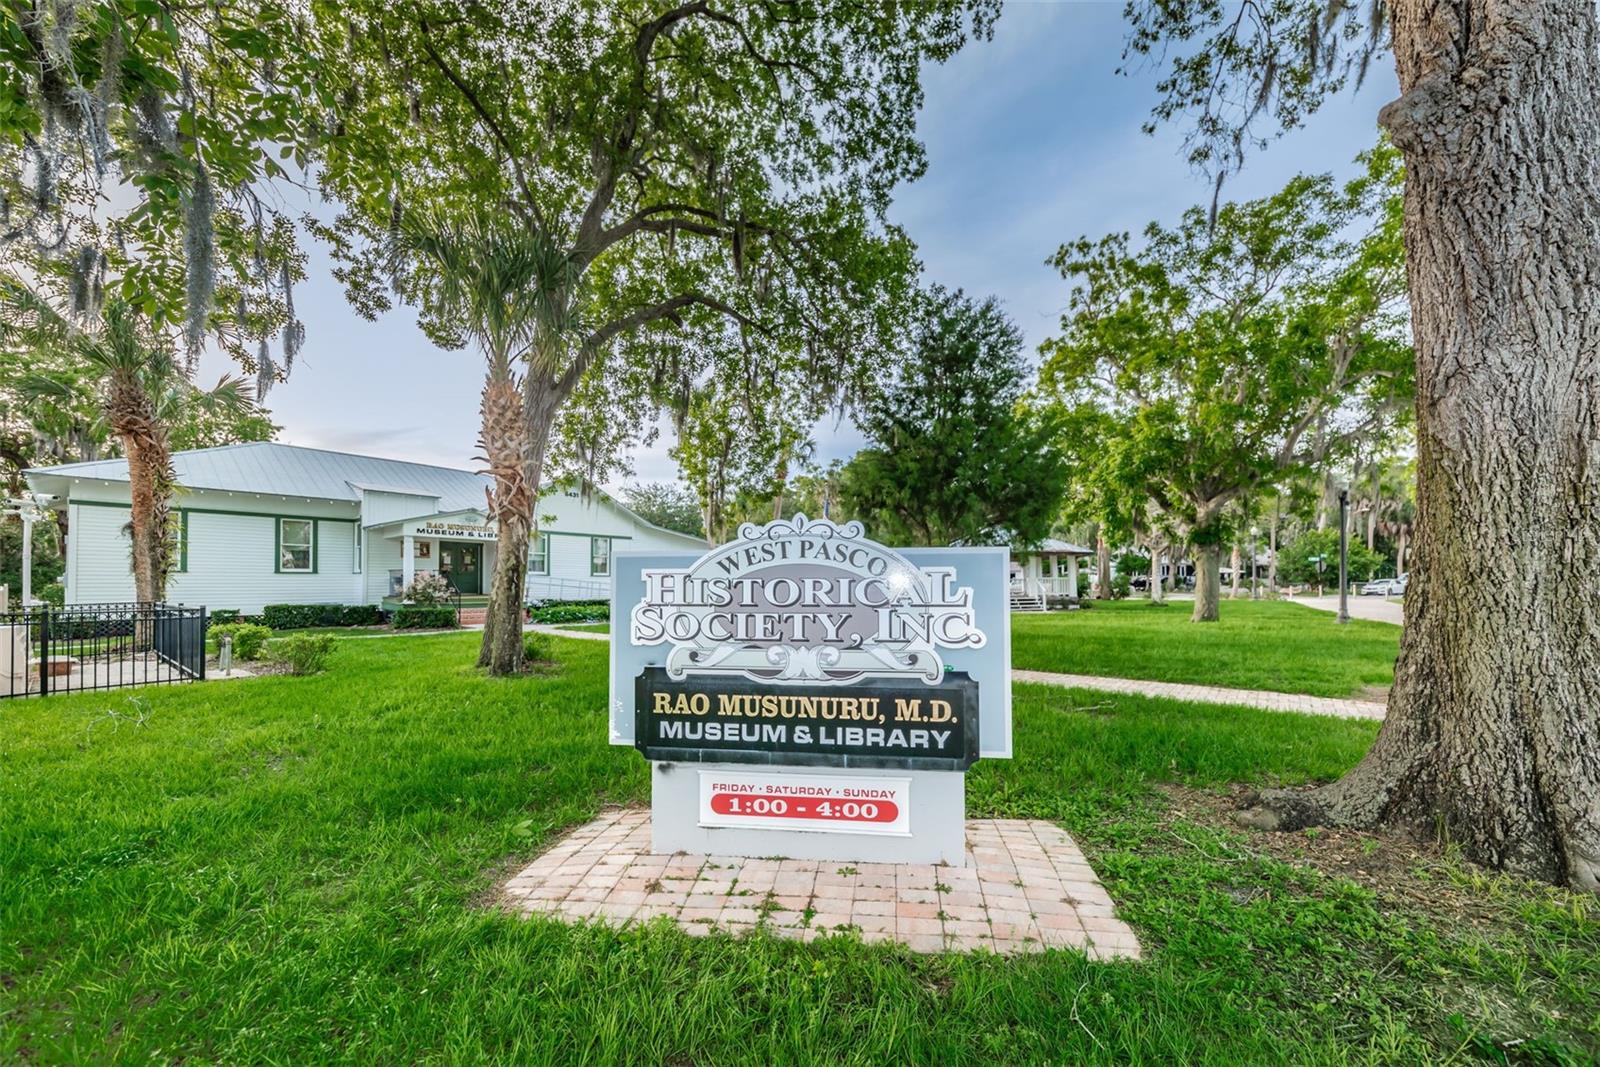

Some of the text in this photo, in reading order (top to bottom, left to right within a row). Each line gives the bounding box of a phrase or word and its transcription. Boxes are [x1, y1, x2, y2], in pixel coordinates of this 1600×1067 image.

[416, 528, 464, 537] MUSEUM
[716, 540, 888, 577] WEST PASCO
[646, 572, 969, 608] HISTORICAL
[635, 606, 982, 649] SOCIETY, INC.
[653, 692, 958, 724] RAO MUSUNURU, M.D.
[659, 721, 951, 749] MUSEUM & LIBRARY
[712, 783, 896, 799] FRIDAY SATURDAY SUNDAY
[729, 798, 788, 814] 1:00
[816, 802, 879, 819] 4:00
